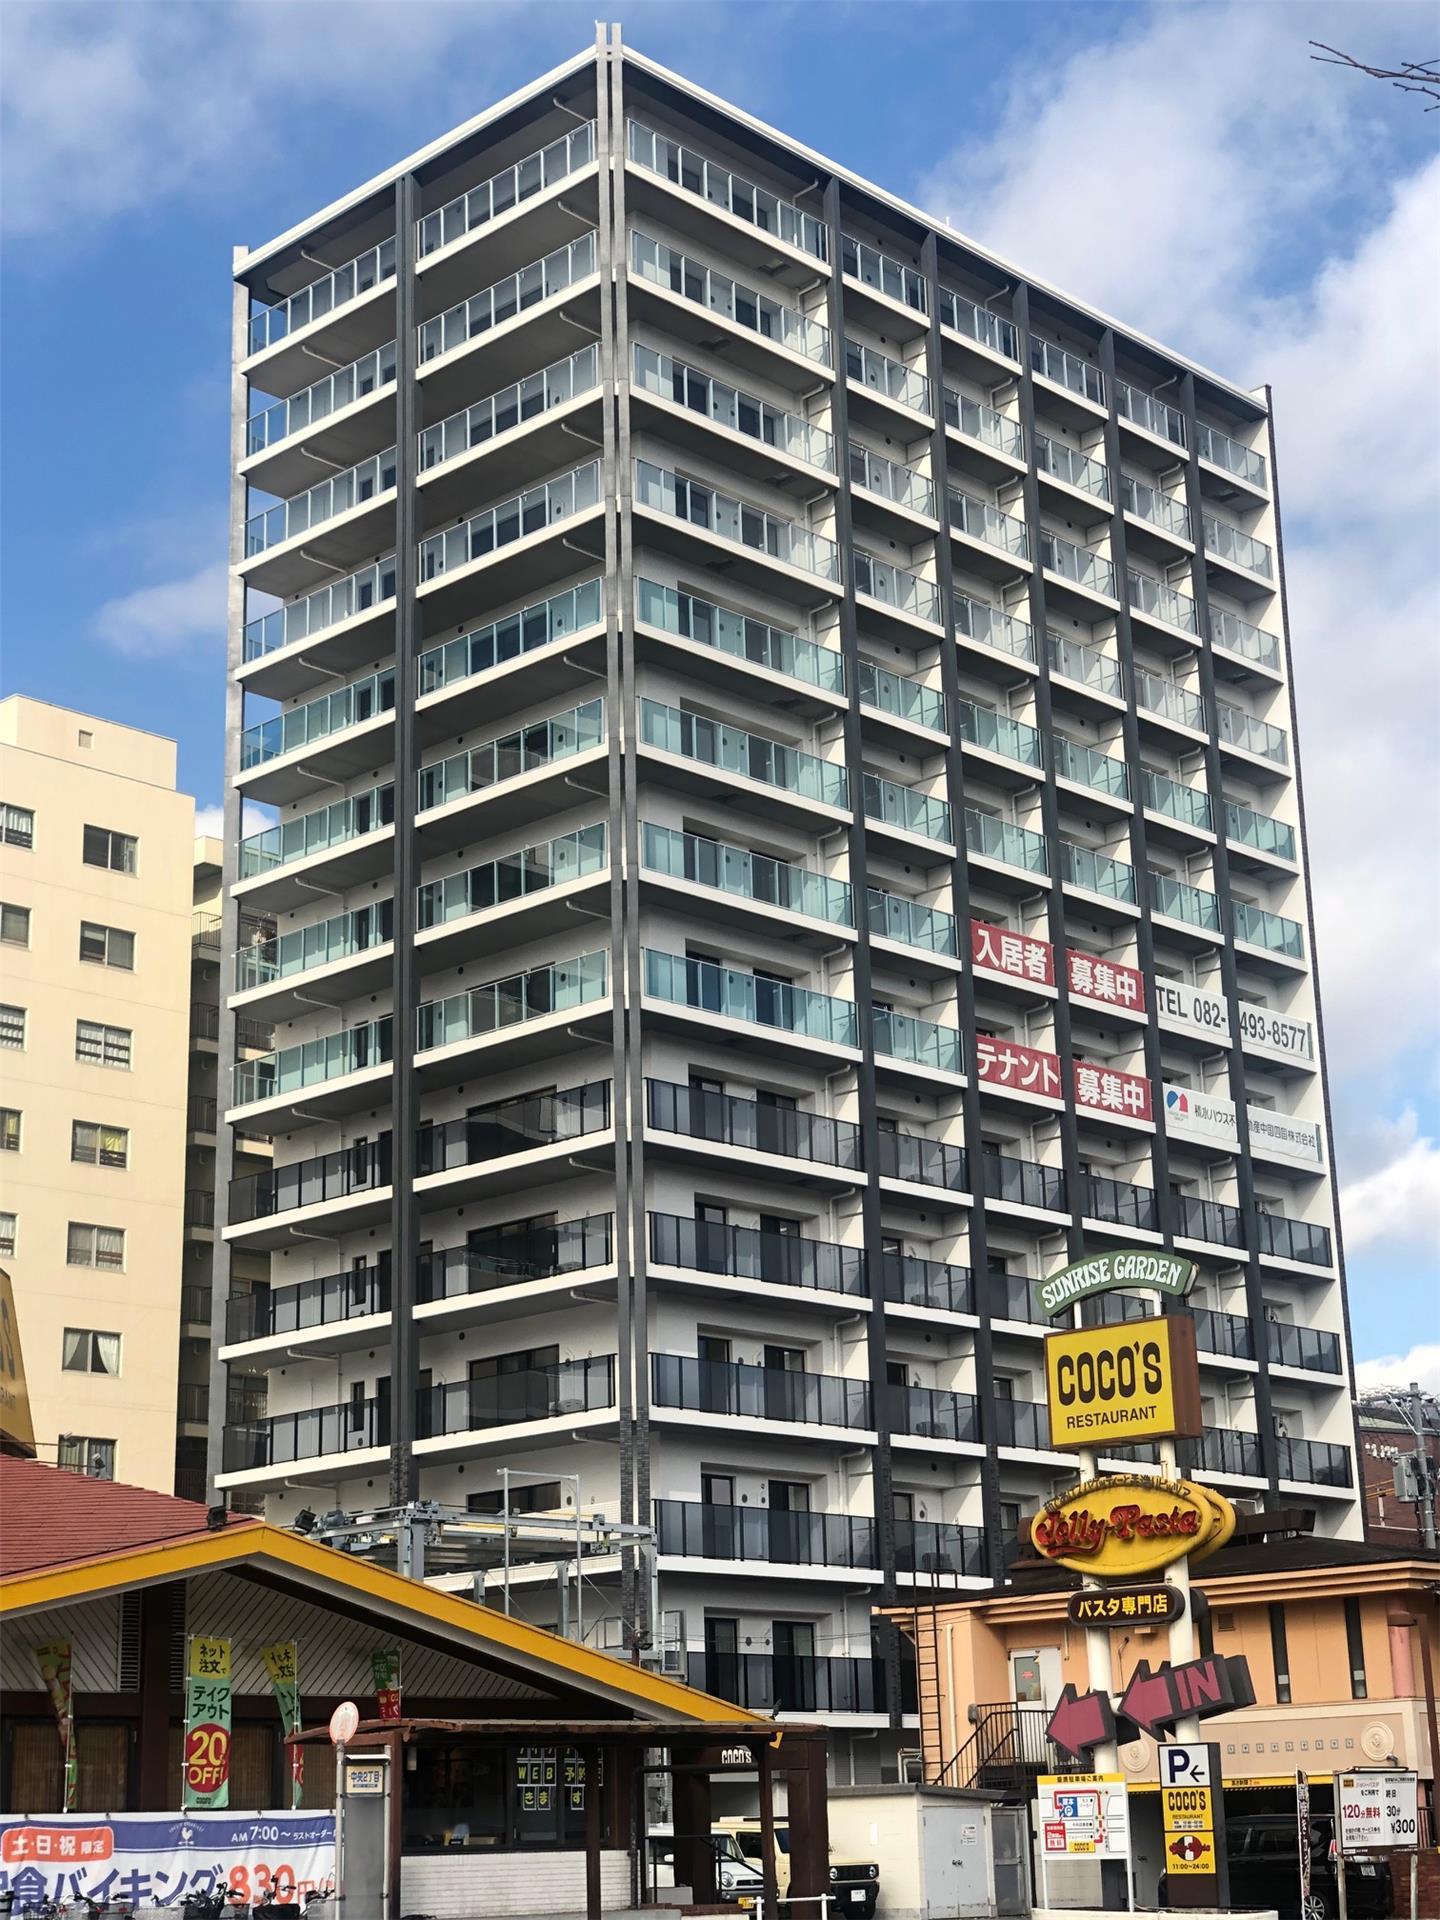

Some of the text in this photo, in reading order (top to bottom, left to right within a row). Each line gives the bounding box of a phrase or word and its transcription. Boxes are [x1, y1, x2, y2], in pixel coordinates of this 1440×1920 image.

[976, 929, 1047, 982] 入居者
[1070, 956, 1137, 1006] 募集中
[1155, 986, 1226, 1029] TEL 082-
[1240, 1011, 1306, 1052] 493-8577
[976, 1043, 1059, 1092] テナント
[1077, 1067, 1145, 1115] 募集中
[1041, 1255, 1182, 1309] SUNRISE GARDEN
[1057, 1341, 1162, 1406] COCO'S
[1066, 1405, 1157, 1429] RESTAURANT
[1077, 1594, 1168, 1618] パスタ専門店
[200, 1643, 225, 1659] ネット
[1174, 1660, 1222, 1711] IN
[192, 1703, 230, 1720] アウト
[518, 1767, 553, 1779] WEB
[721, 1749, 752, 1764] COCO'S
[1168, 1749, 1190, 1783] P
[188, 1767, 224, 1785] OFF!
[1168, 1790, 1206, 1811] COCO'S
[231, 1833, 248, 1842] AM
[1390, 1819, 1415, 1834] ¥300
[0, 1863, 224, 1916] 食バイキング
